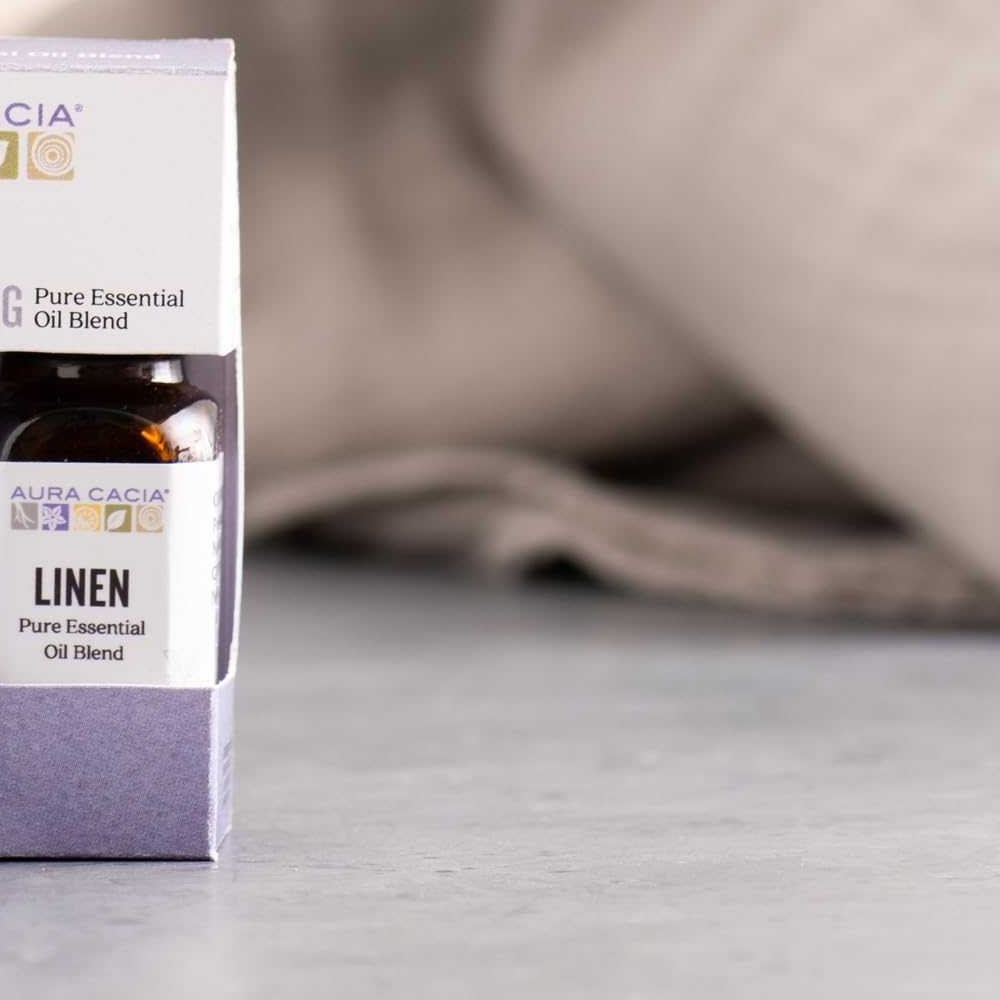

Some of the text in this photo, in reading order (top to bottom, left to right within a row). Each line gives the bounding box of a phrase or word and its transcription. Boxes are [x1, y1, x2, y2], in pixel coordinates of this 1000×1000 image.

[34, 287, 185, 308] Pure Essential
[34, 310, 128, 330] Oil Blend
[10, 486, 80, 501] AURA
[34, 567, 129, 607] LINEN
[19, 618, 146, 636] Pure Essential
[44, 644, 124, 661] Oil Blend
